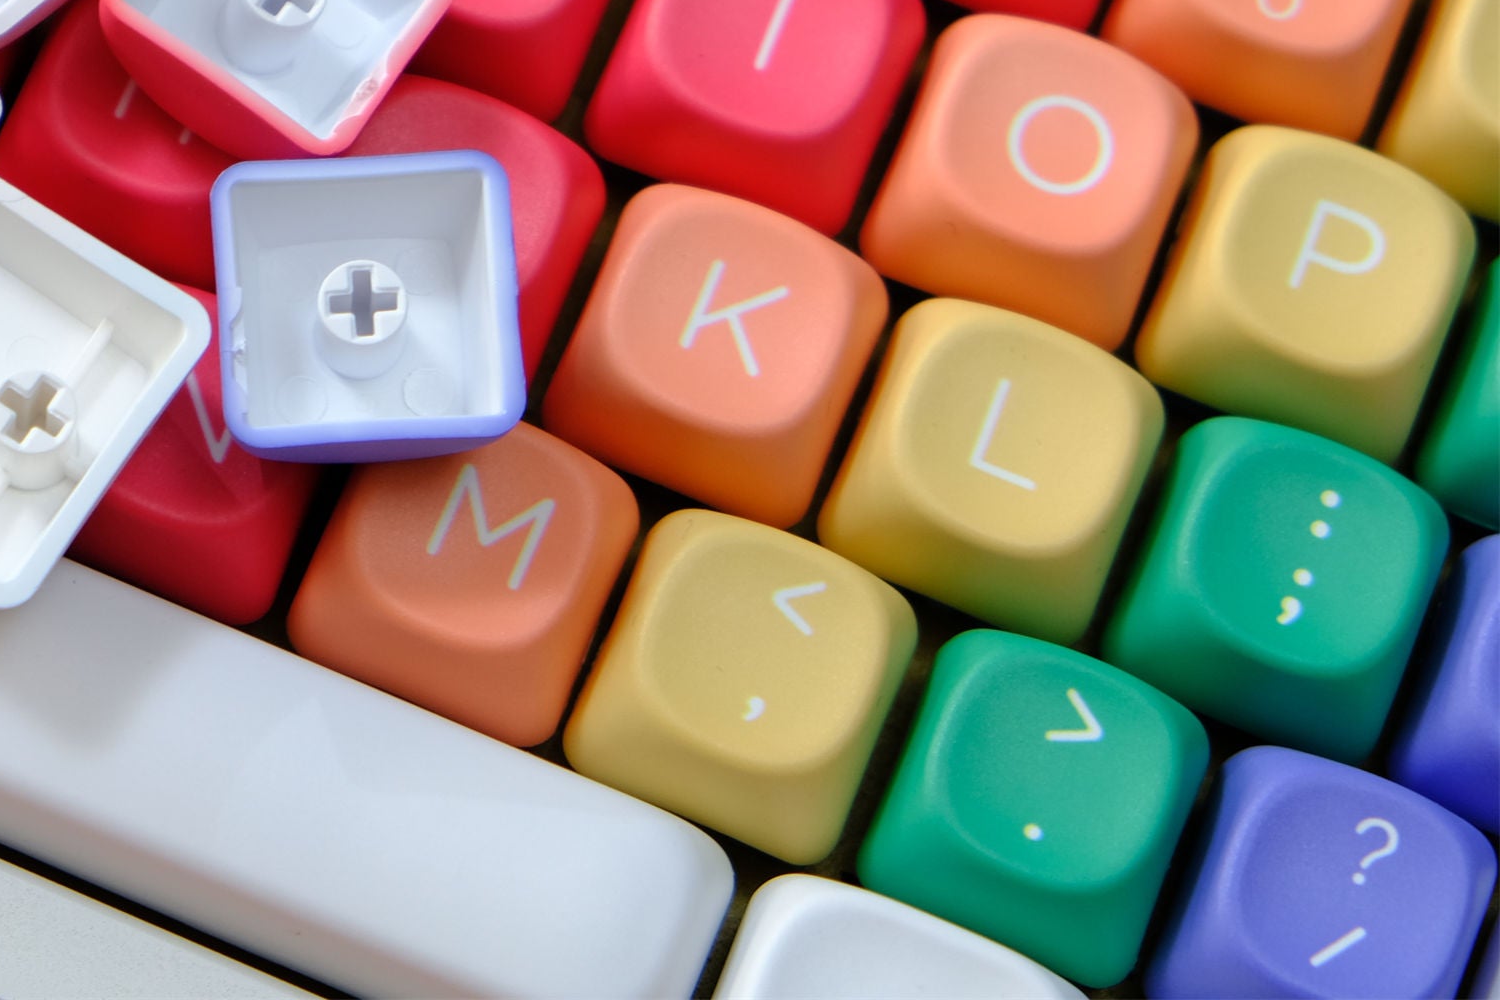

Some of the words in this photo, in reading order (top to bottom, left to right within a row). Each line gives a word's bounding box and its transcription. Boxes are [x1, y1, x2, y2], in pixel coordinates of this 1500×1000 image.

[1007, 95, 1115, 196] O
[1289, 200, 1387, 289] P
[679, 260, 790, 377] K
[970, 379, 1037, 490] L
[426, 464, 556, 590] M
[1353, 818, 1399, 884] ?
